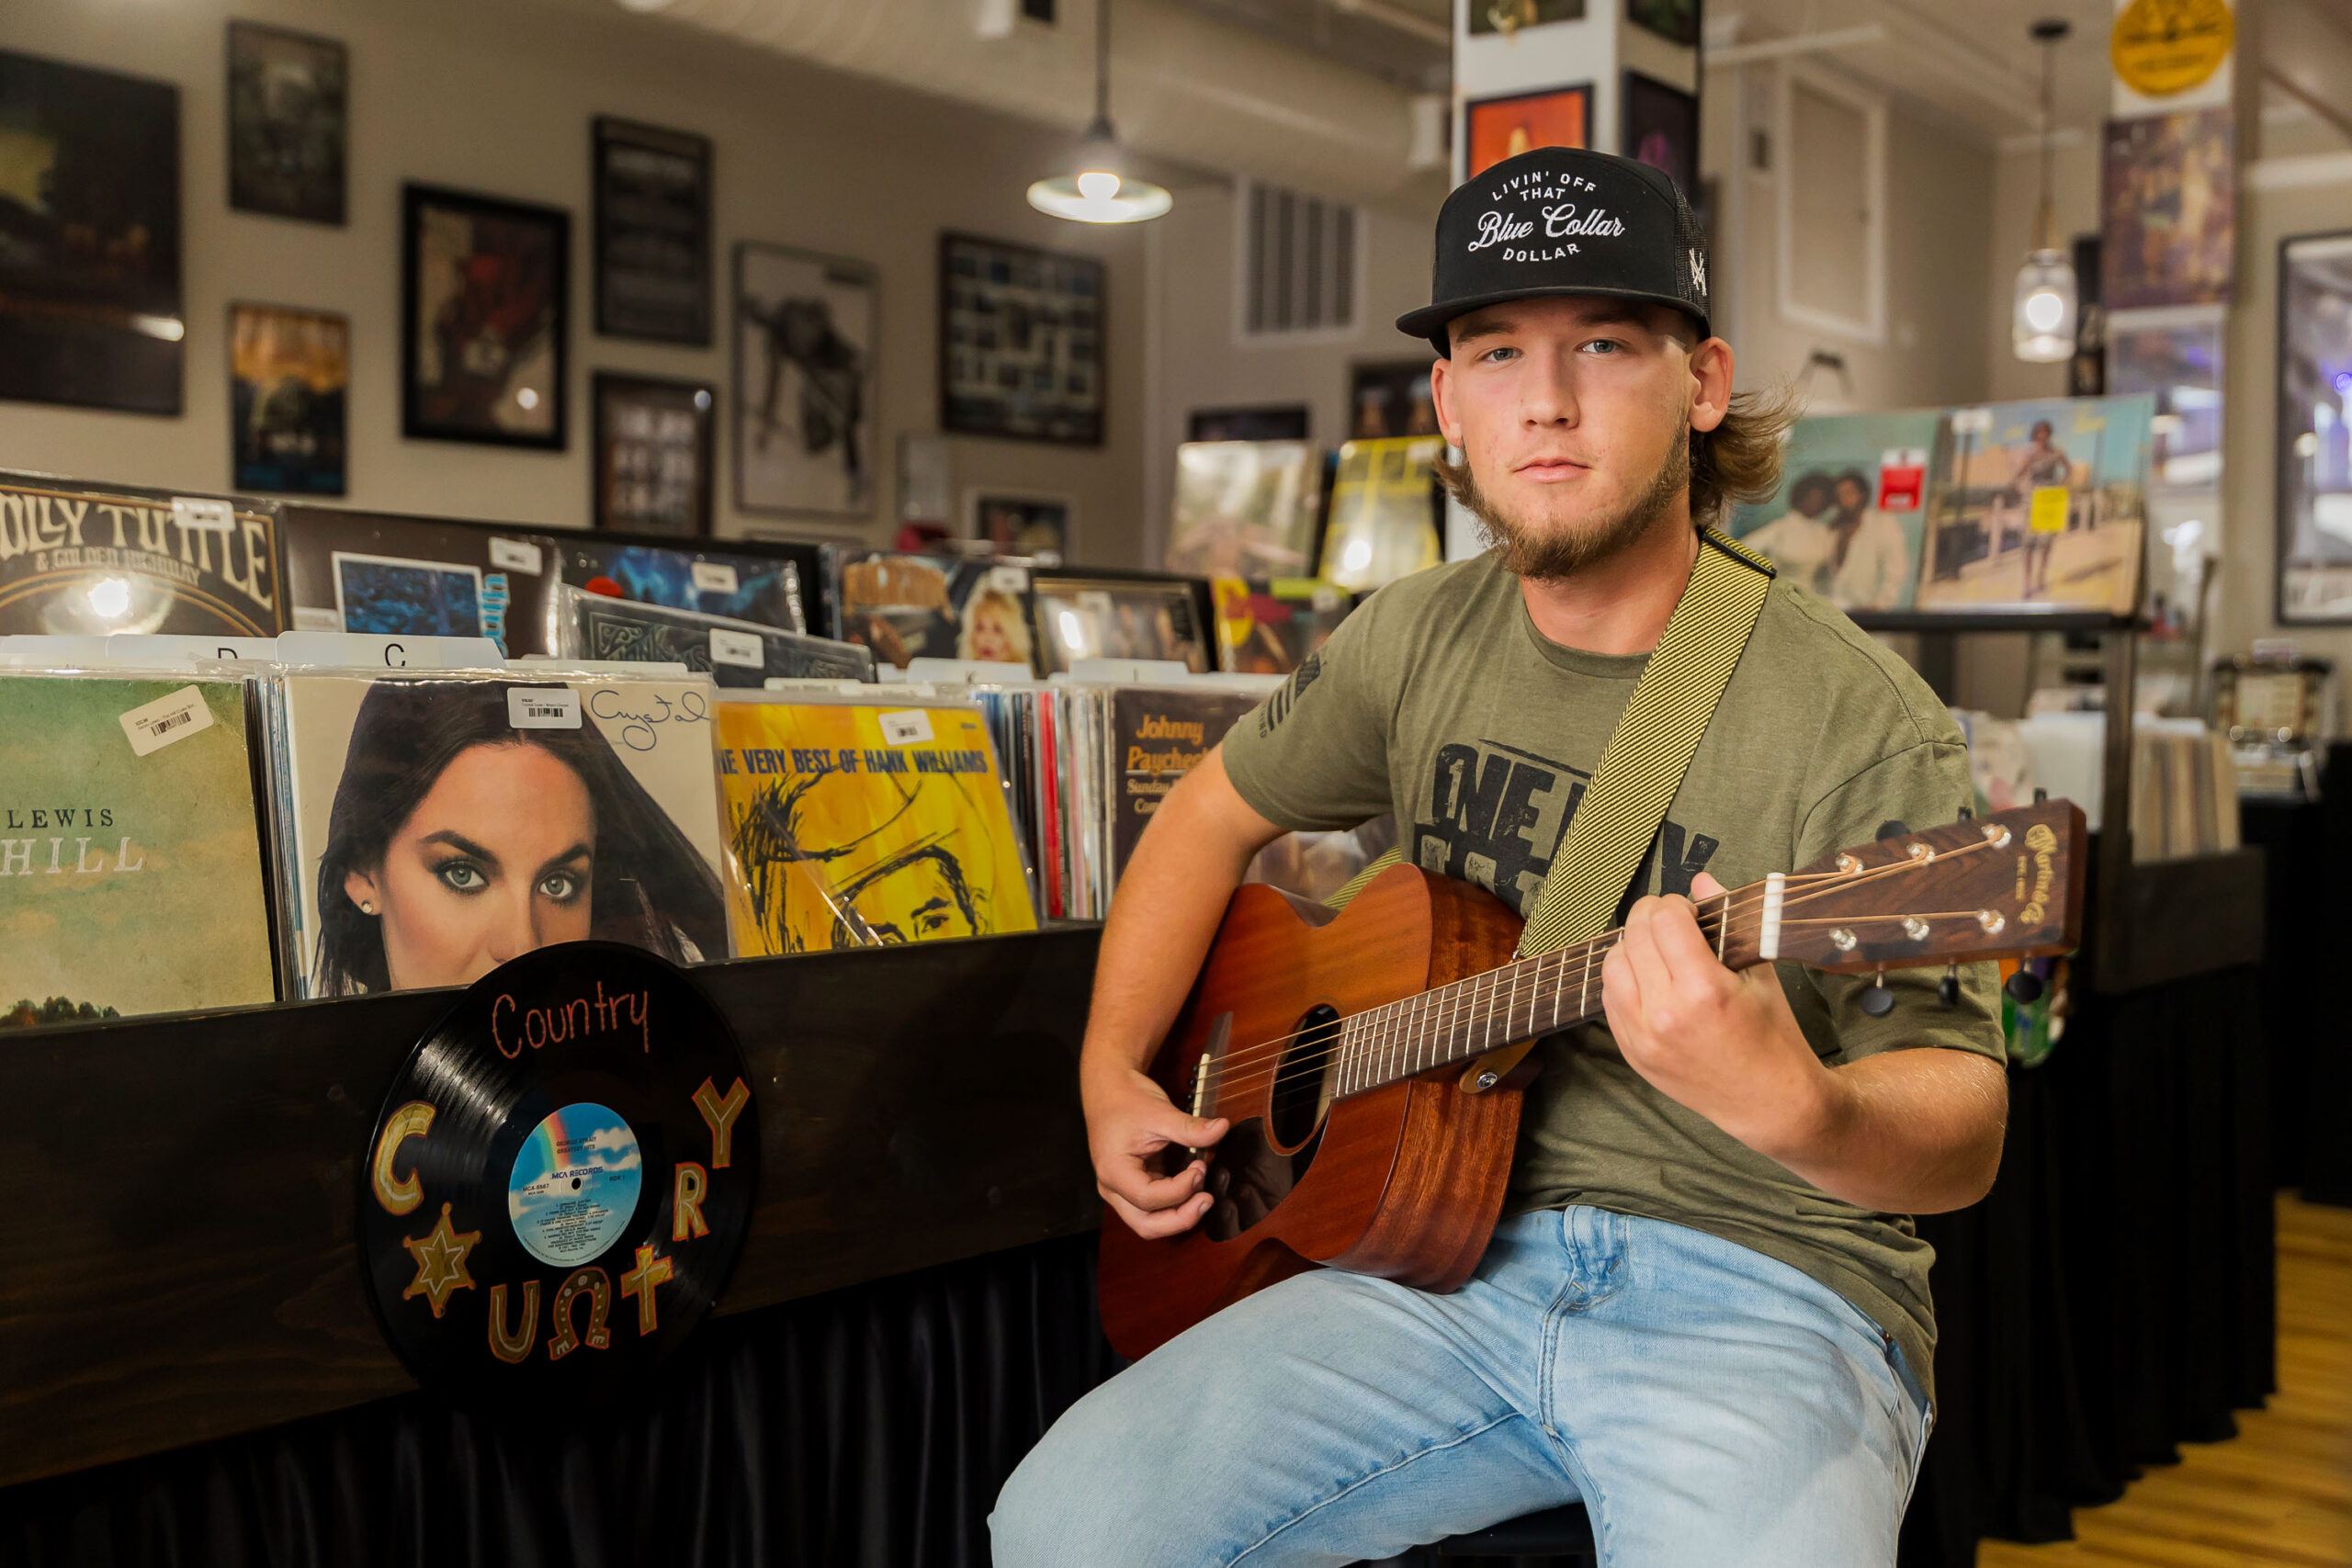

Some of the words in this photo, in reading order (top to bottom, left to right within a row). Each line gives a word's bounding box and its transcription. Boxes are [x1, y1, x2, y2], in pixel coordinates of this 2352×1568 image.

[1492, 171, 1550, 201] LIVIN'
[1560, 173, 1597, 193] OFF
[1520, 187, 1566, 201] THAT
[1468, 210, 1534, 252] Blue
[1542, 204, 1625, 238] Collar
[1502, 243, 1581, 262] DOLLAR
[384, 643, 406, 667] C
[1136, 714, 1204, 746] Johnny
[741, 749, 786, 774] VERY
[791, 749, 831, 774] BEST
[838, 750, 857, 773] OF
[863, 750, 909, 773] HANK
[912, 750, 988, 773] WILLIAMS
[7, 808, 114, 829] LEWIS
[0, 837, 143, 875] HILL
[492, 981, 650, 1059] Country
[551, 1172, 569, 1180] MCA
[570, 1167, 604, 1178] RECORDS
